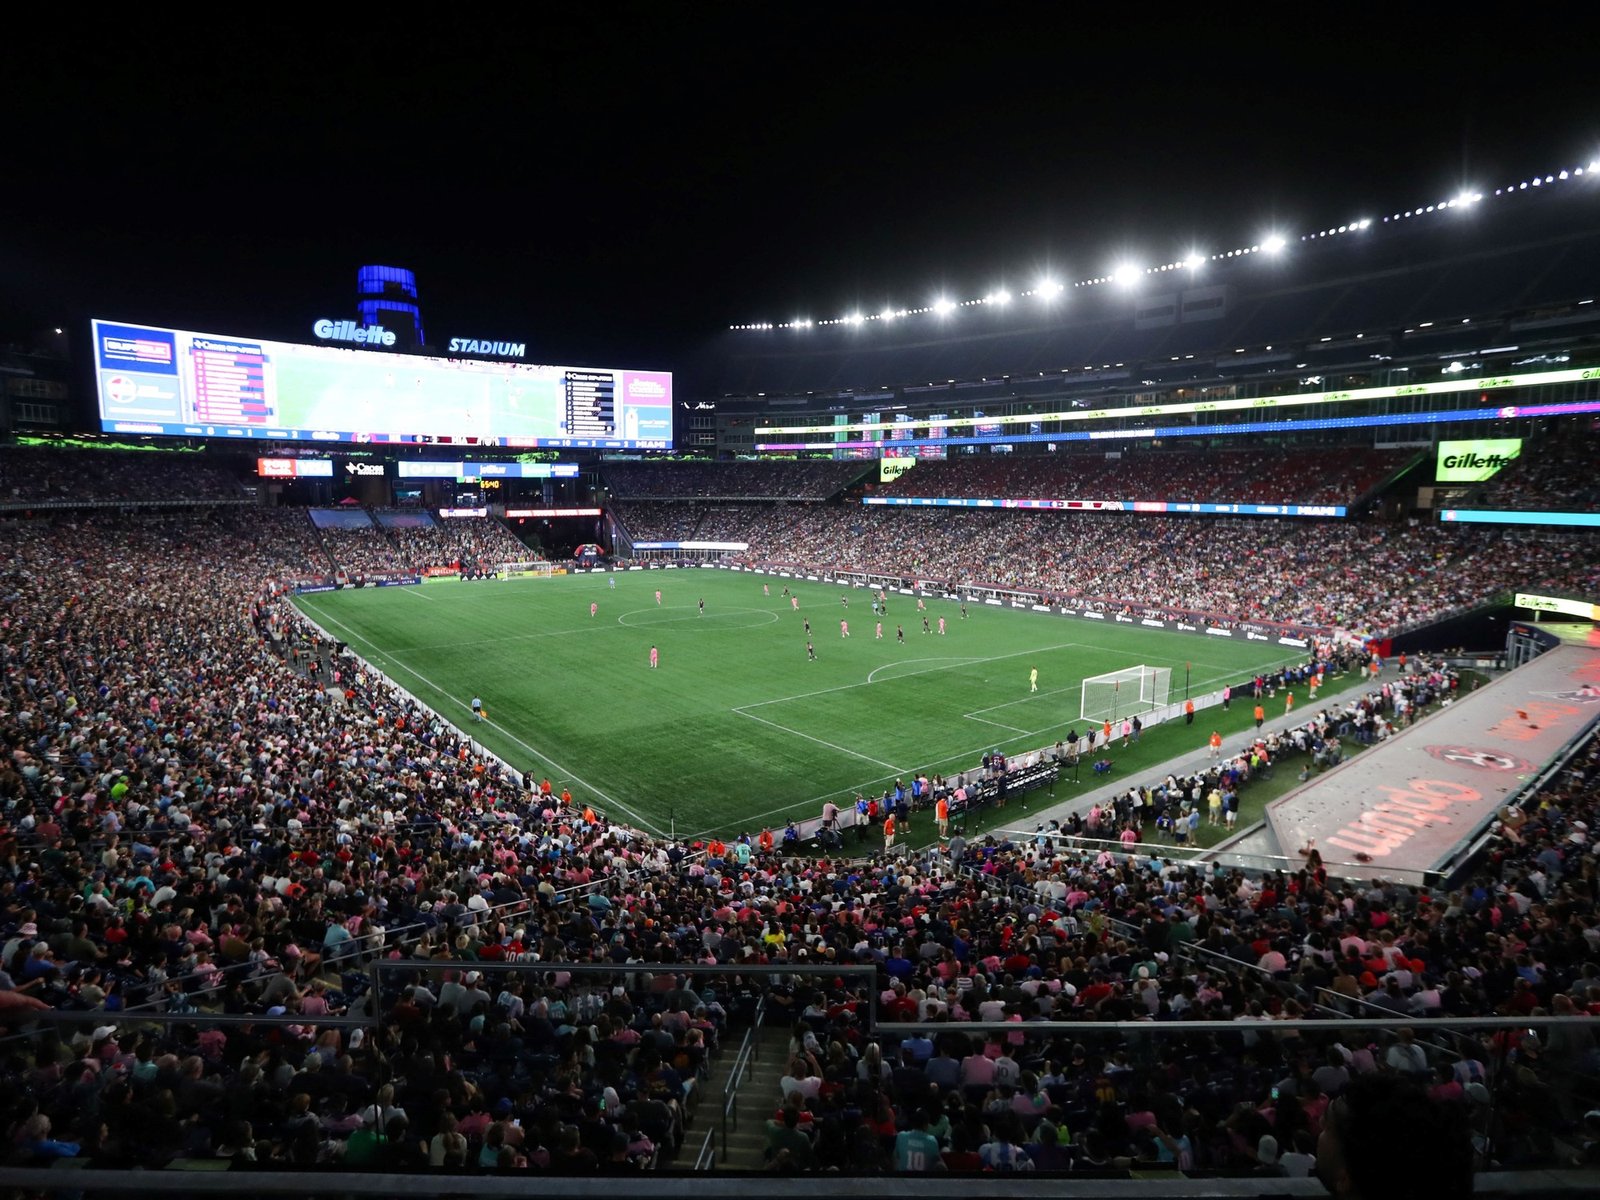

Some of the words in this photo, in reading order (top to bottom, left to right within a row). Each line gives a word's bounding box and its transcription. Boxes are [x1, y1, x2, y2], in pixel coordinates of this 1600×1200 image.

[313, 319, 395, 345] Gillette
[448, 338, 525, 356] STADIUM
[1443, 453, 1509, 468] Gillette
[883, 465, 909, 475] Gillett
[1297, 506, 1336, 515] MIAMI
[906, 1150, 924, 1171] 10
